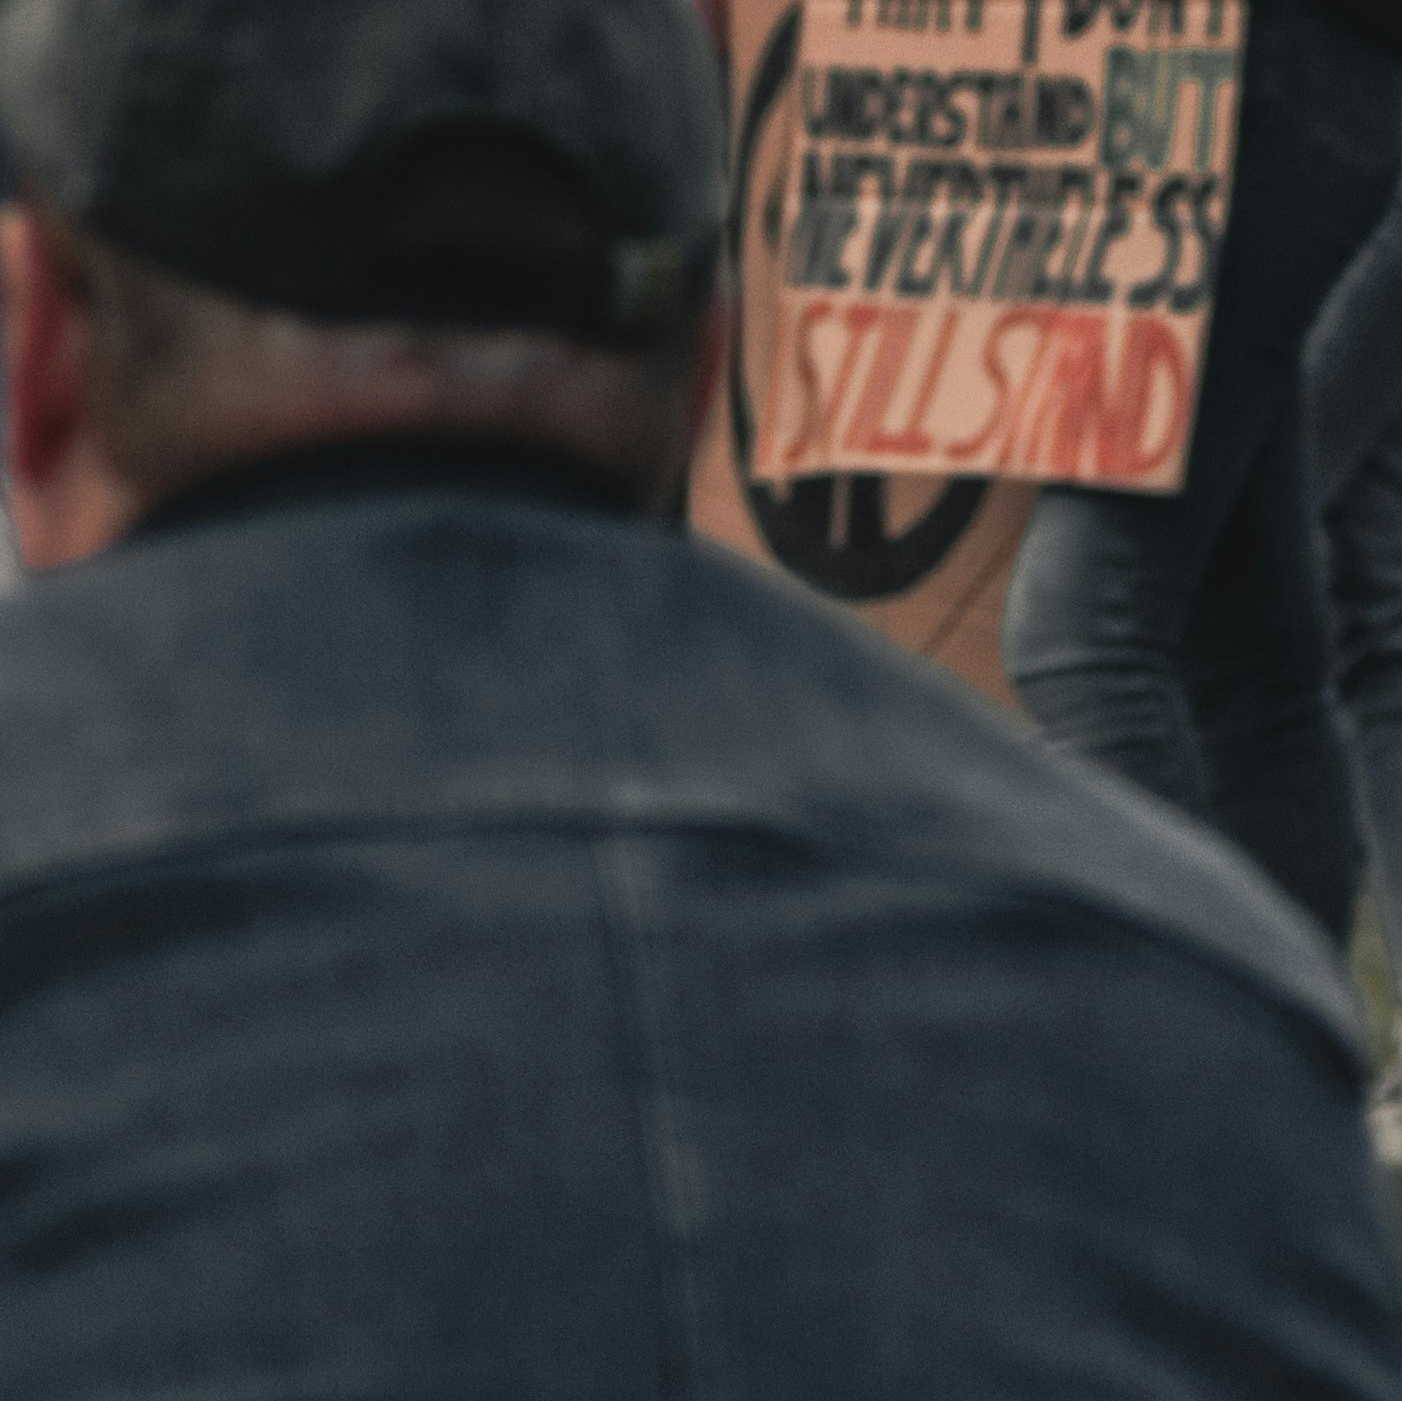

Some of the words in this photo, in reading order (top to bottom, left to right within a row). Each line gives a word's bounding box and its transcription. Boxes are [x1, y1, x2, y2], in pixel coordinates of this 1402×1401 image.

[804, 65, 1096, 150] UNDERSTAND
[1101, 44, 1238, 172] BUT
[946, 304, 1189, 476] STAND
